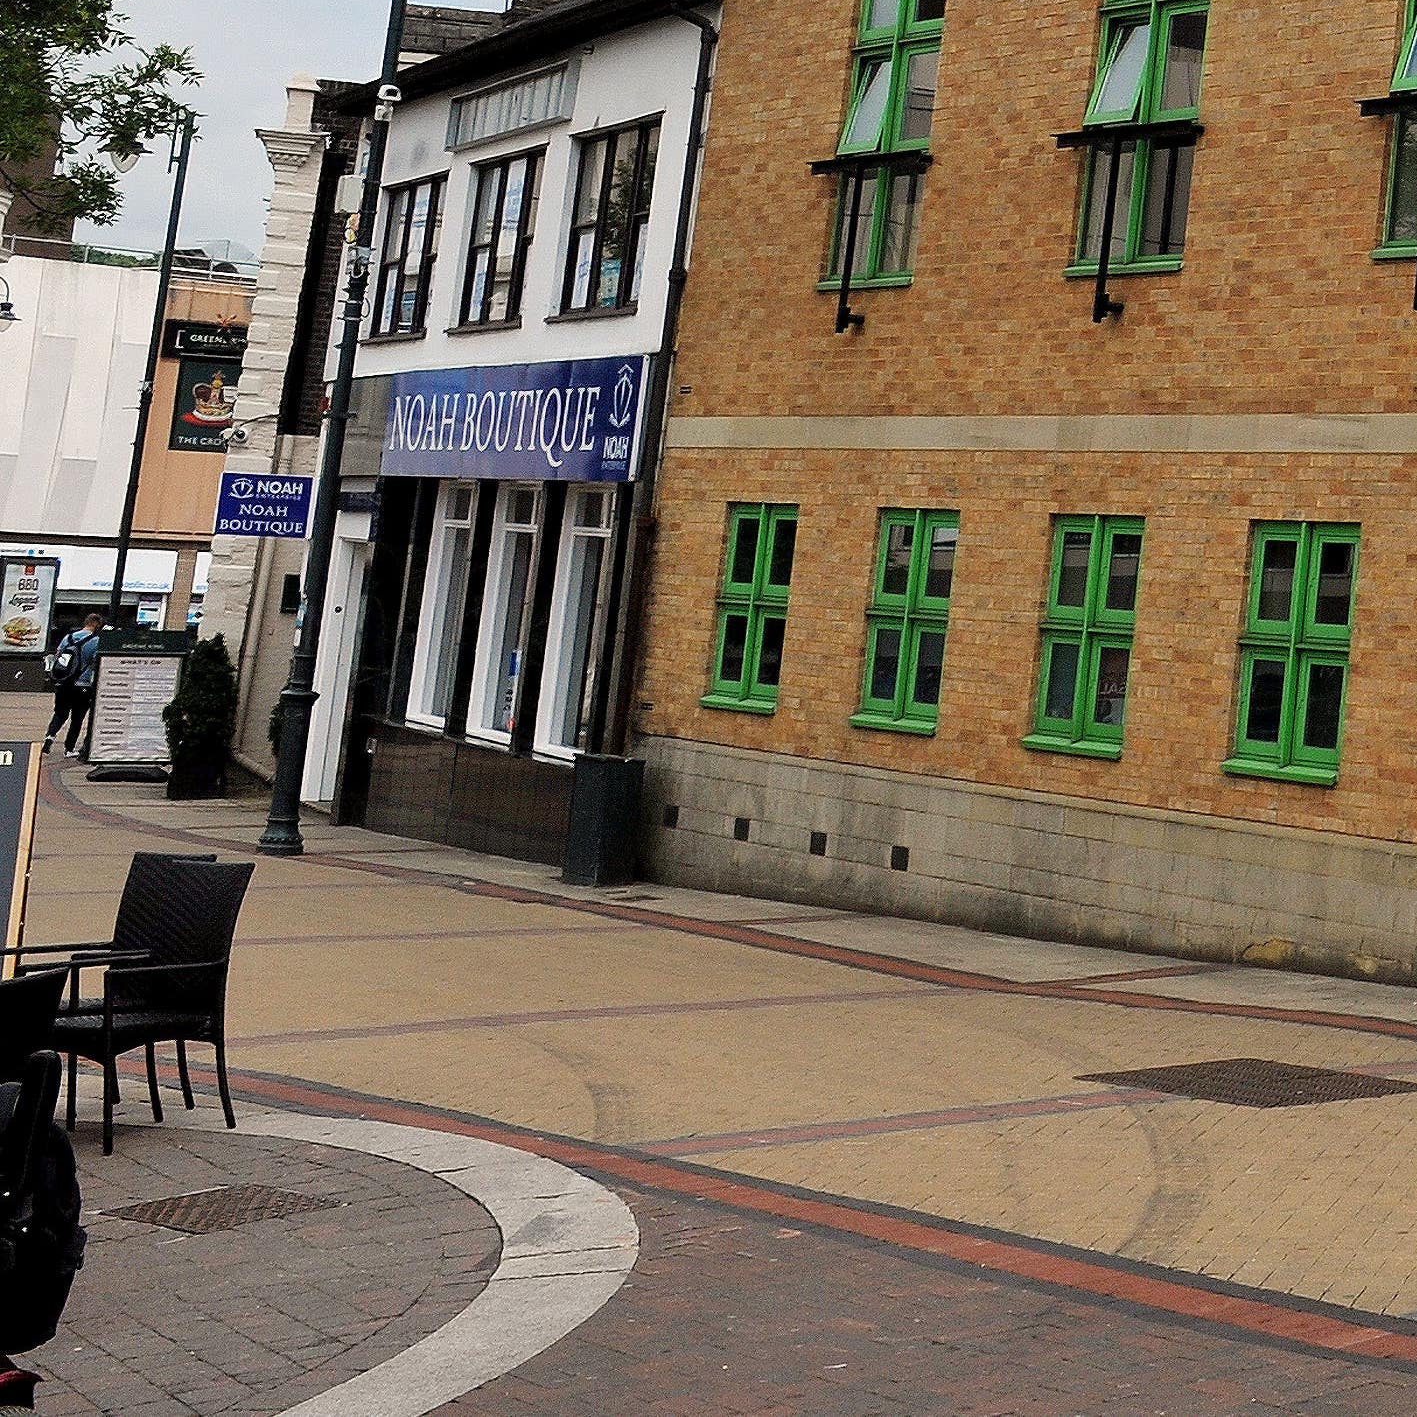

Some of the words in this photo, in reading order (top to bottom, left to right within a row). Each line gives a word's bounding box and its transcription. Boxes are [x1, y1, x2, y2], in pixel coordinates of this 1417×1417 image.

[388, 392, 460, 452] NOAH
[459, 386, 601, 468] BOUTIQUE
[199, 437, 226, 447] CRO
[602, 436, 630, 460] NOAH
[256, 480, 304, 495] NOAH
[238, 503, 289, 518] NOAH
[219, 518, 304, 536] BOUTIQUE
